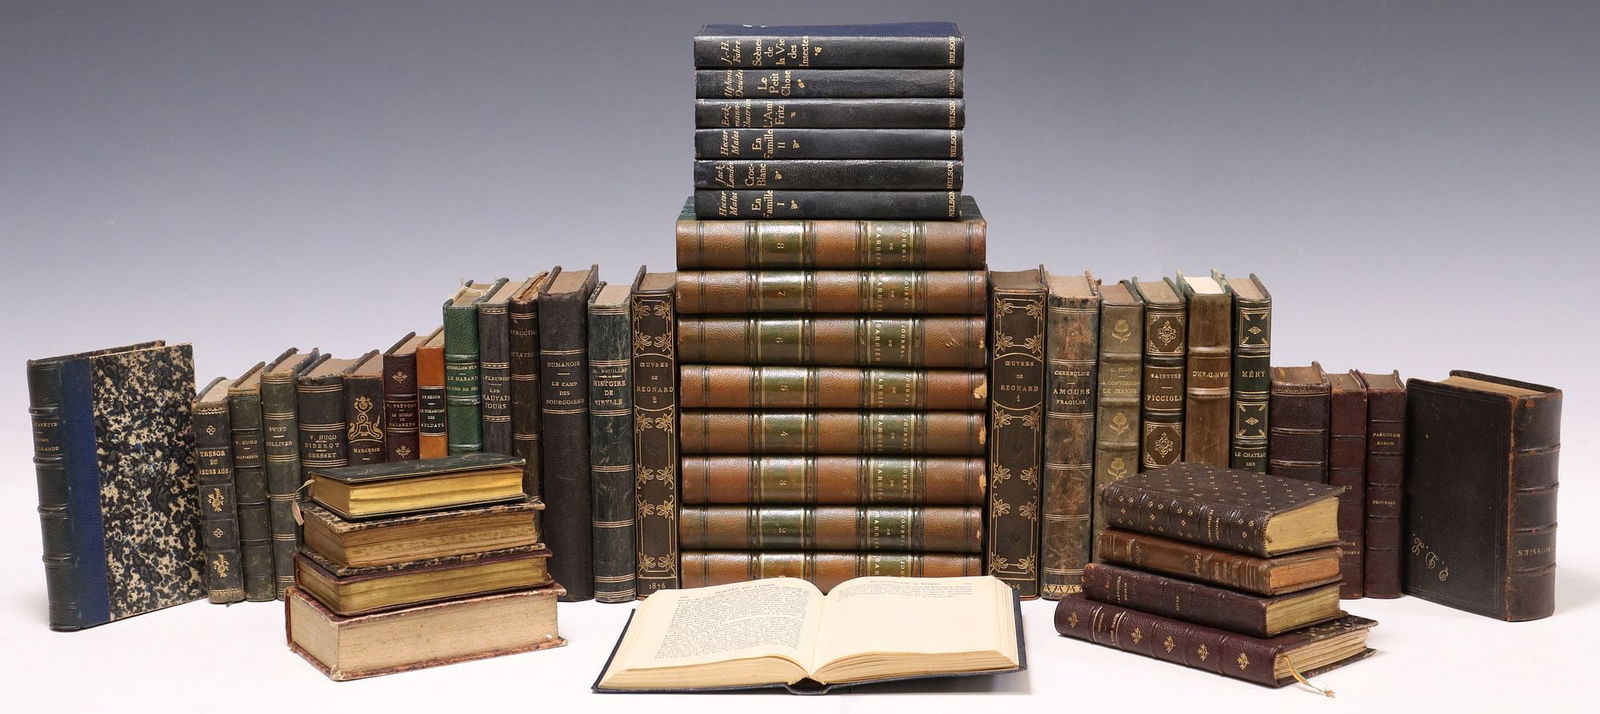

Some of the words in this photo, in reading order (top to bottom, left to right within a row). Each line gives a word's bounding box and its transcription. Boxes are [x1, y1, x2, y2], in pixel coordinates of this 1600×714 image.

[733, 40, 741, 63] Fabre
[764, 46, 774, 57] de
[776, 38, 785, 55] Vie
[787, 44, 797, 59] des
[757, 77, 767, 90] Le
[769, 72, 779, 94] Petit
[781, 70, 791, 97] Chose
[775, 104, 785, 125] Fritz
[752, 138, 762, 150] En
[714, 164, 726, 184] Jack
[756, 163, 767, 187] Blanc
[751, 198, 762, 211] En
[1241, 369, 1266, 378] MÉRY
[1000, 384, 1039, 392] REGNARD
